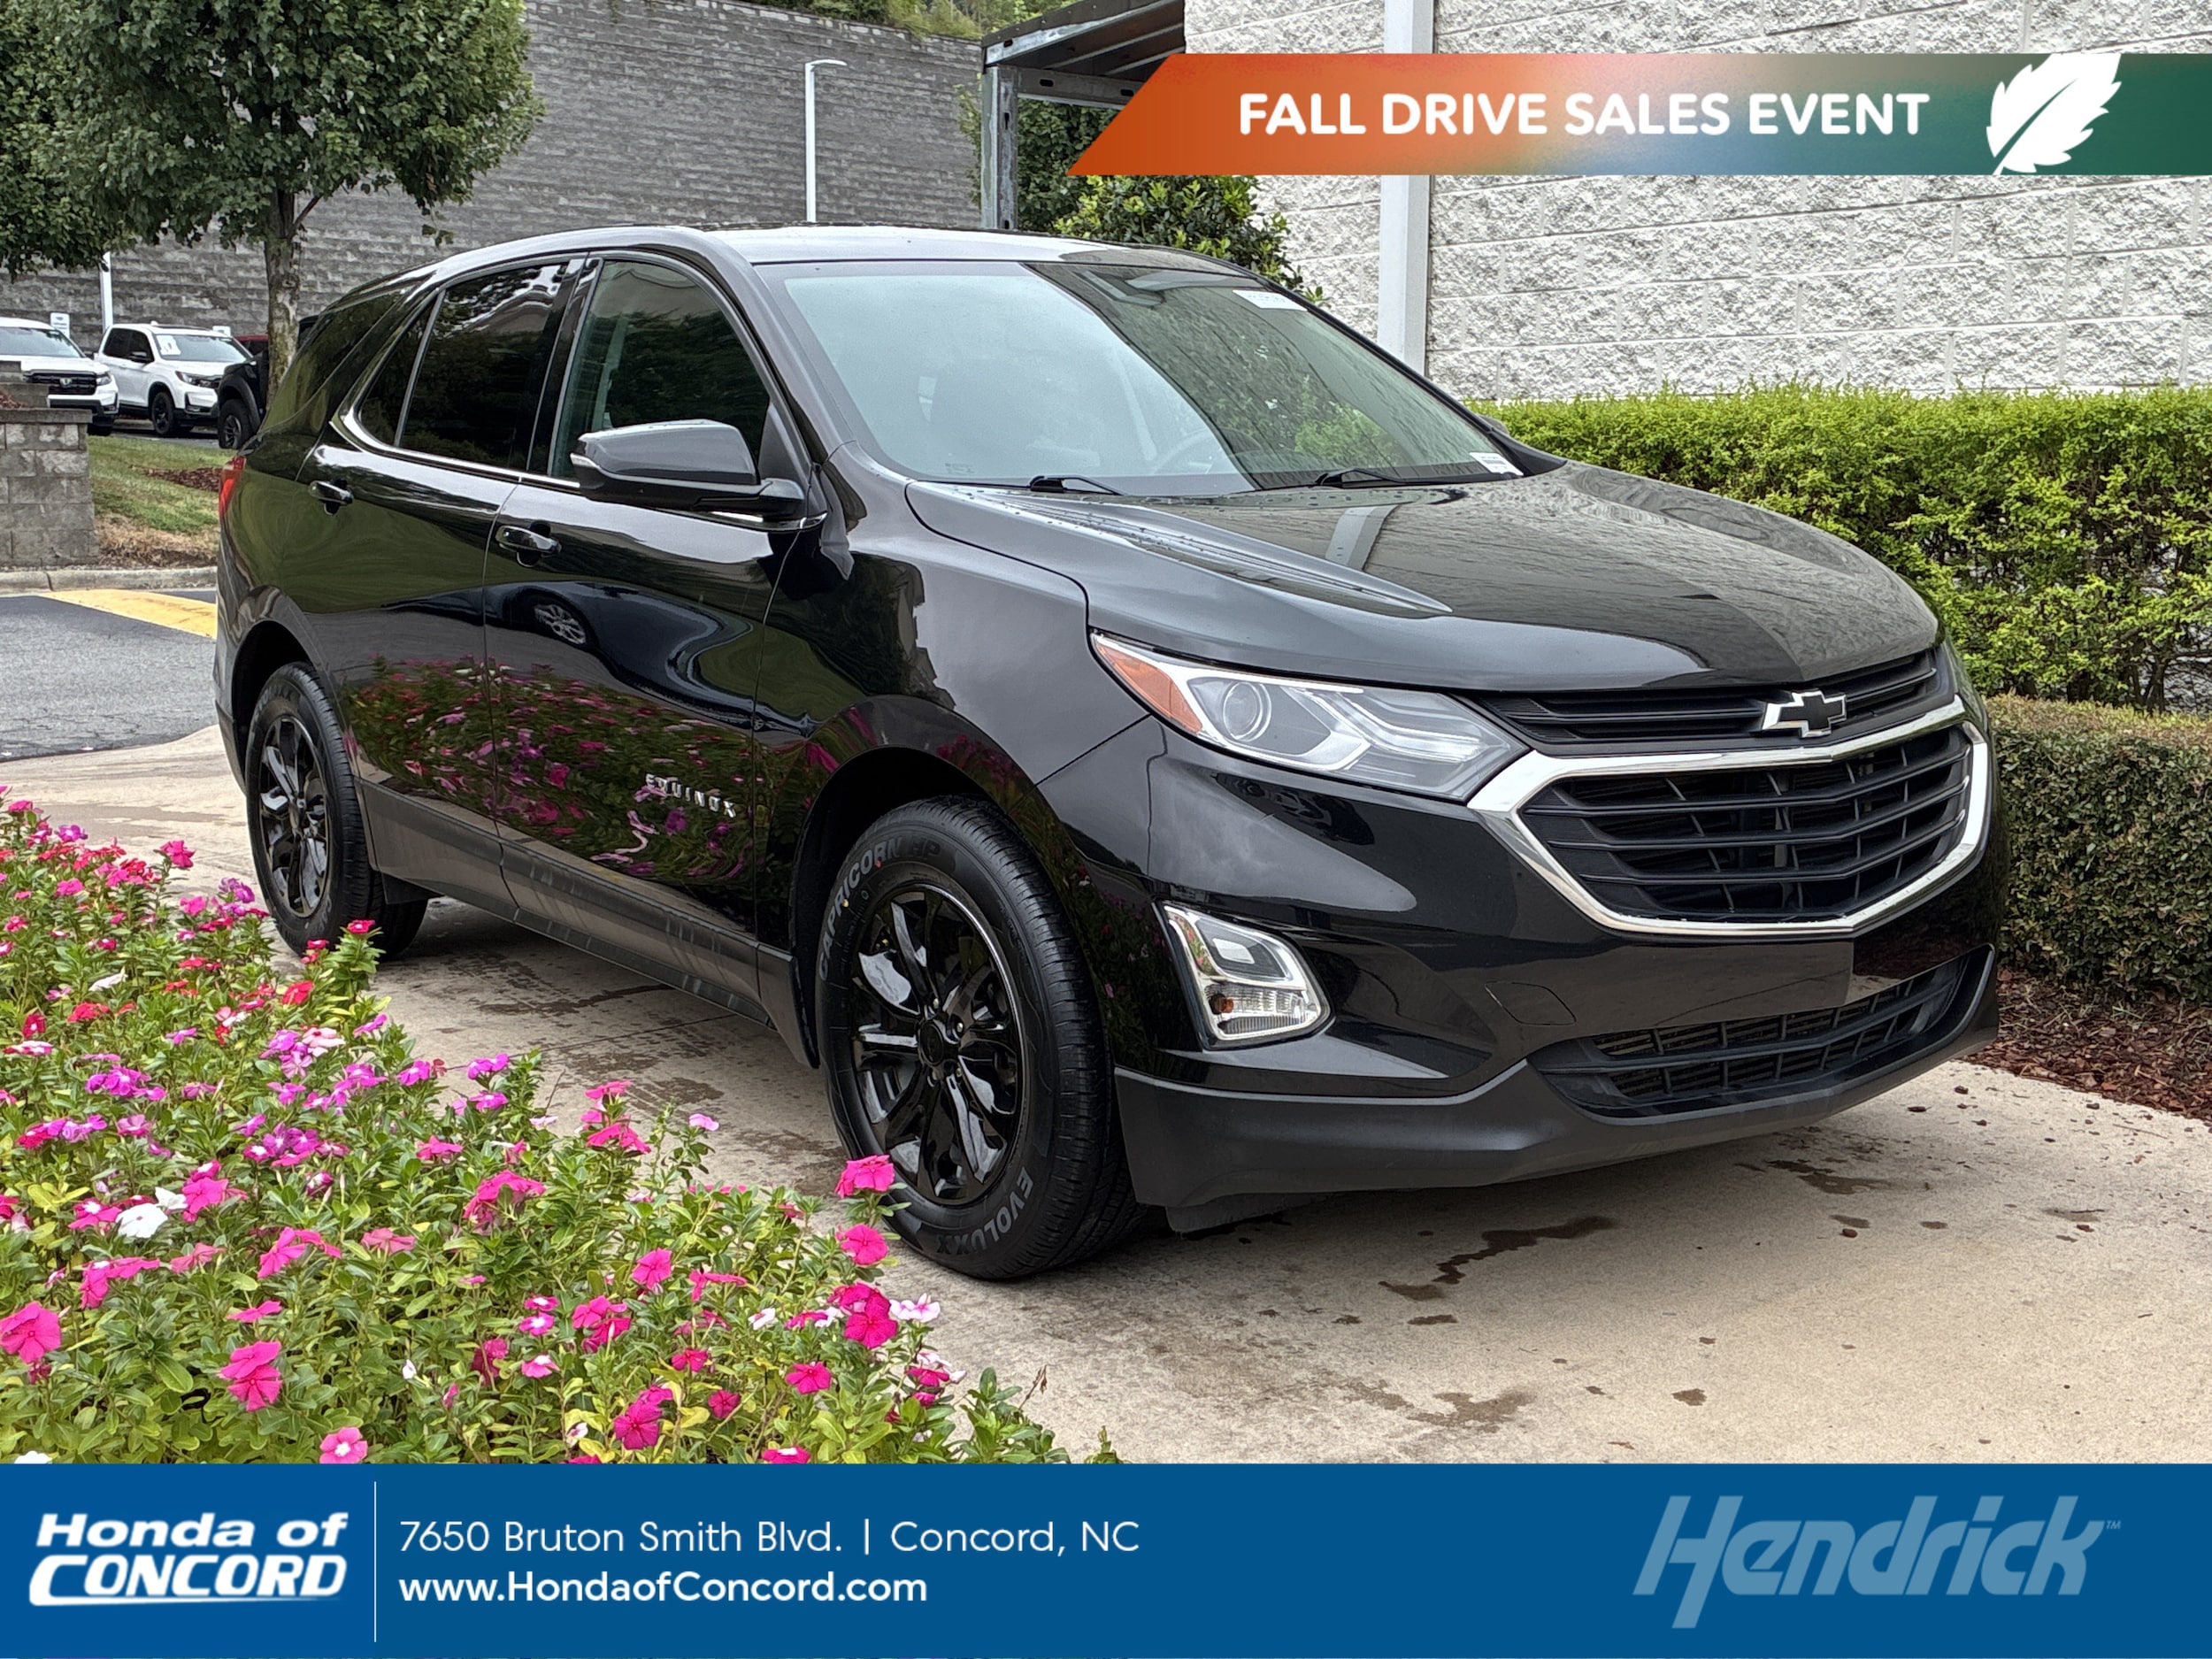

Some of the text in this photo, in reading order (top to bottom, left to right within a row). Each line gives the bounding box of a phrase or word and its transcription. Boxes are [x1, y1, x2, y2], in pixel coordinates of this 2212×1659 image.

[645, 773, 736, 818] EQUINOX
[818, 836, 902, 981] CAPRICORN
[936, 1165, 1034, 1256] EVOLUXX
